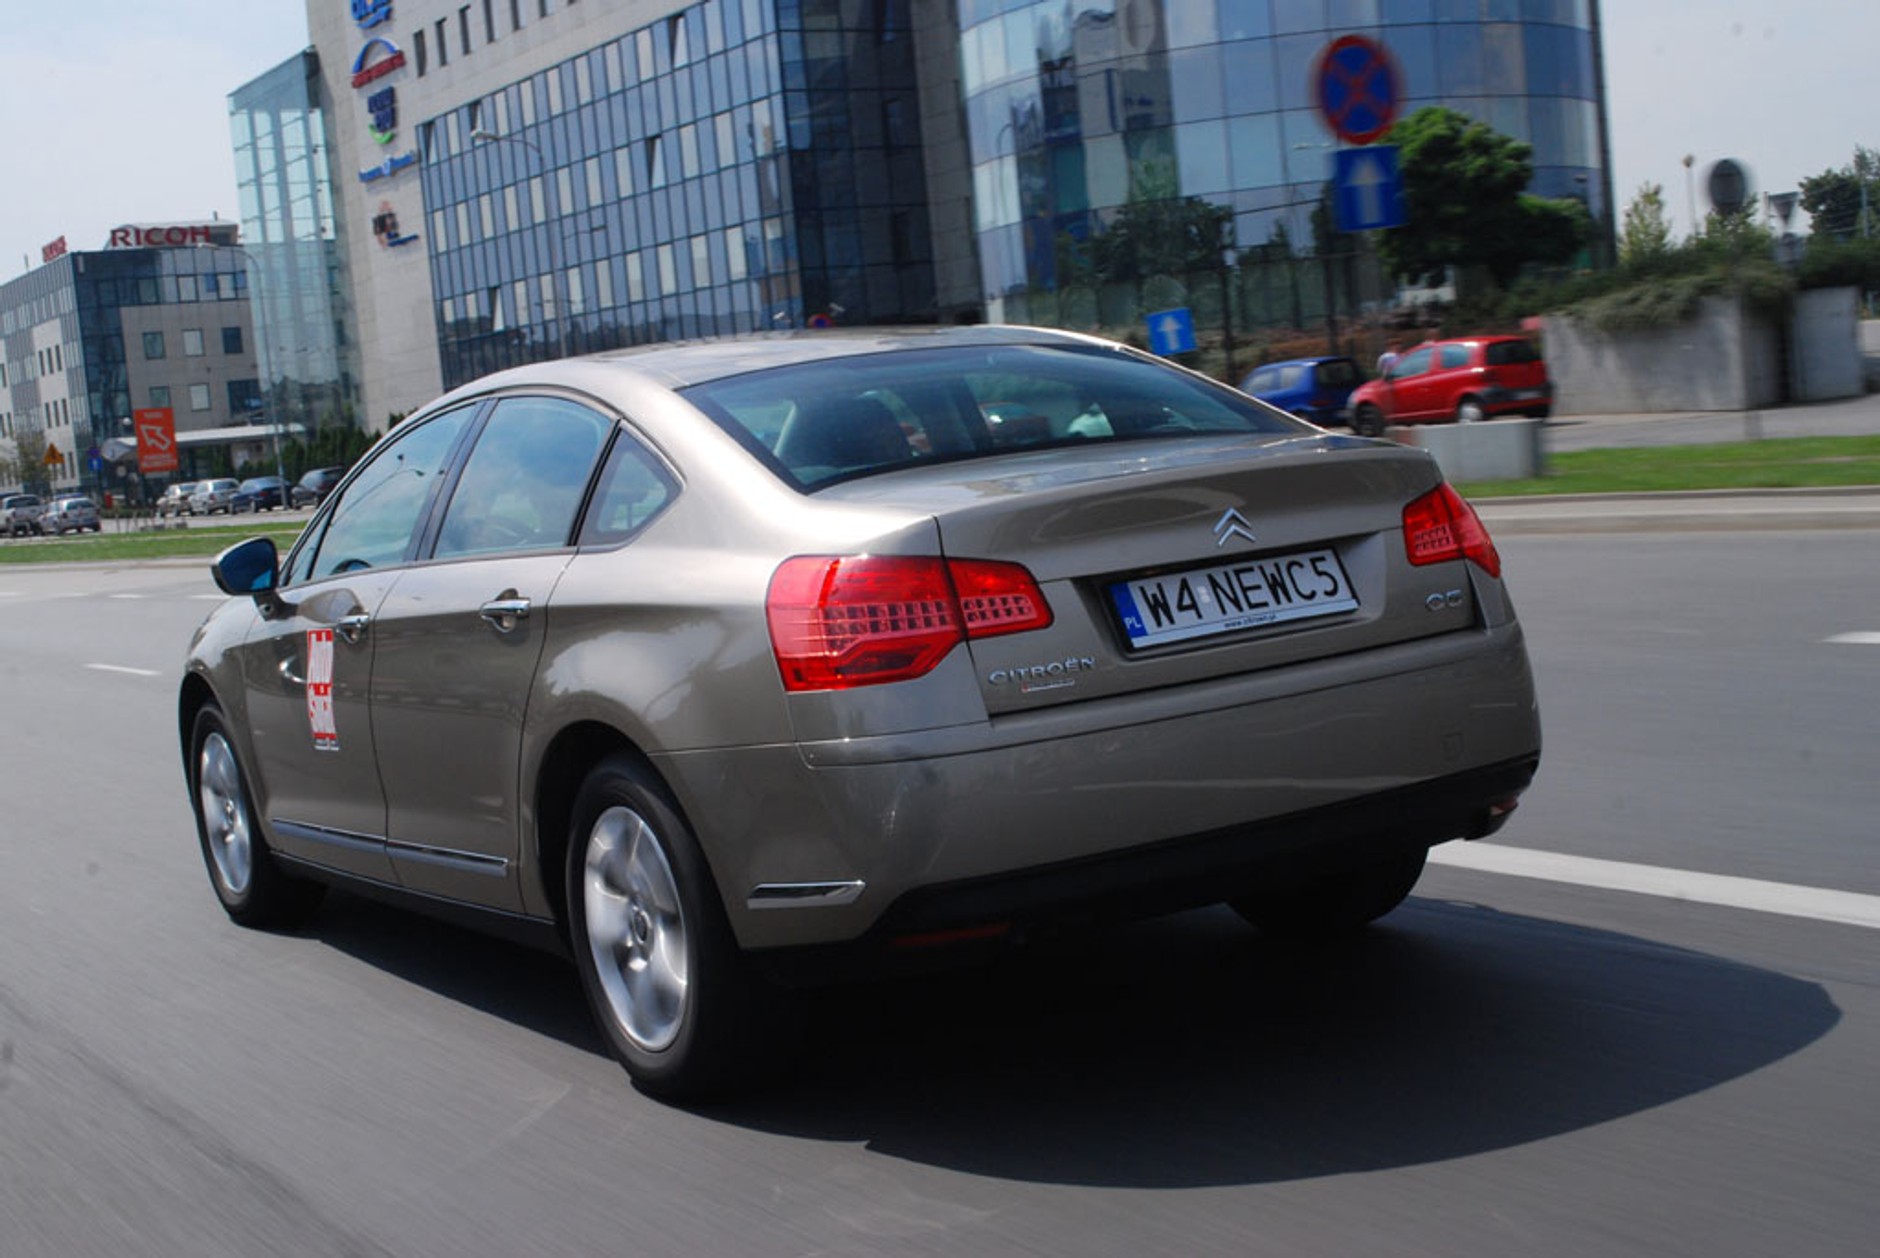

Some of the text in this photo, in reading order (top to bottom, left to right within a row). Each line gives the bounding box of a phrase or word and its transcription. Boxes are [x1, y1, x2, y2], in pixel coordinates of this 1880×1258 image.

[110, 225, 211, 247] RICOH
[1138, 556, 1340, 628] W4 NEWC5
[1124, 616, 1142, 630] PL
[988, 656, 1095, 685] CITROËN
